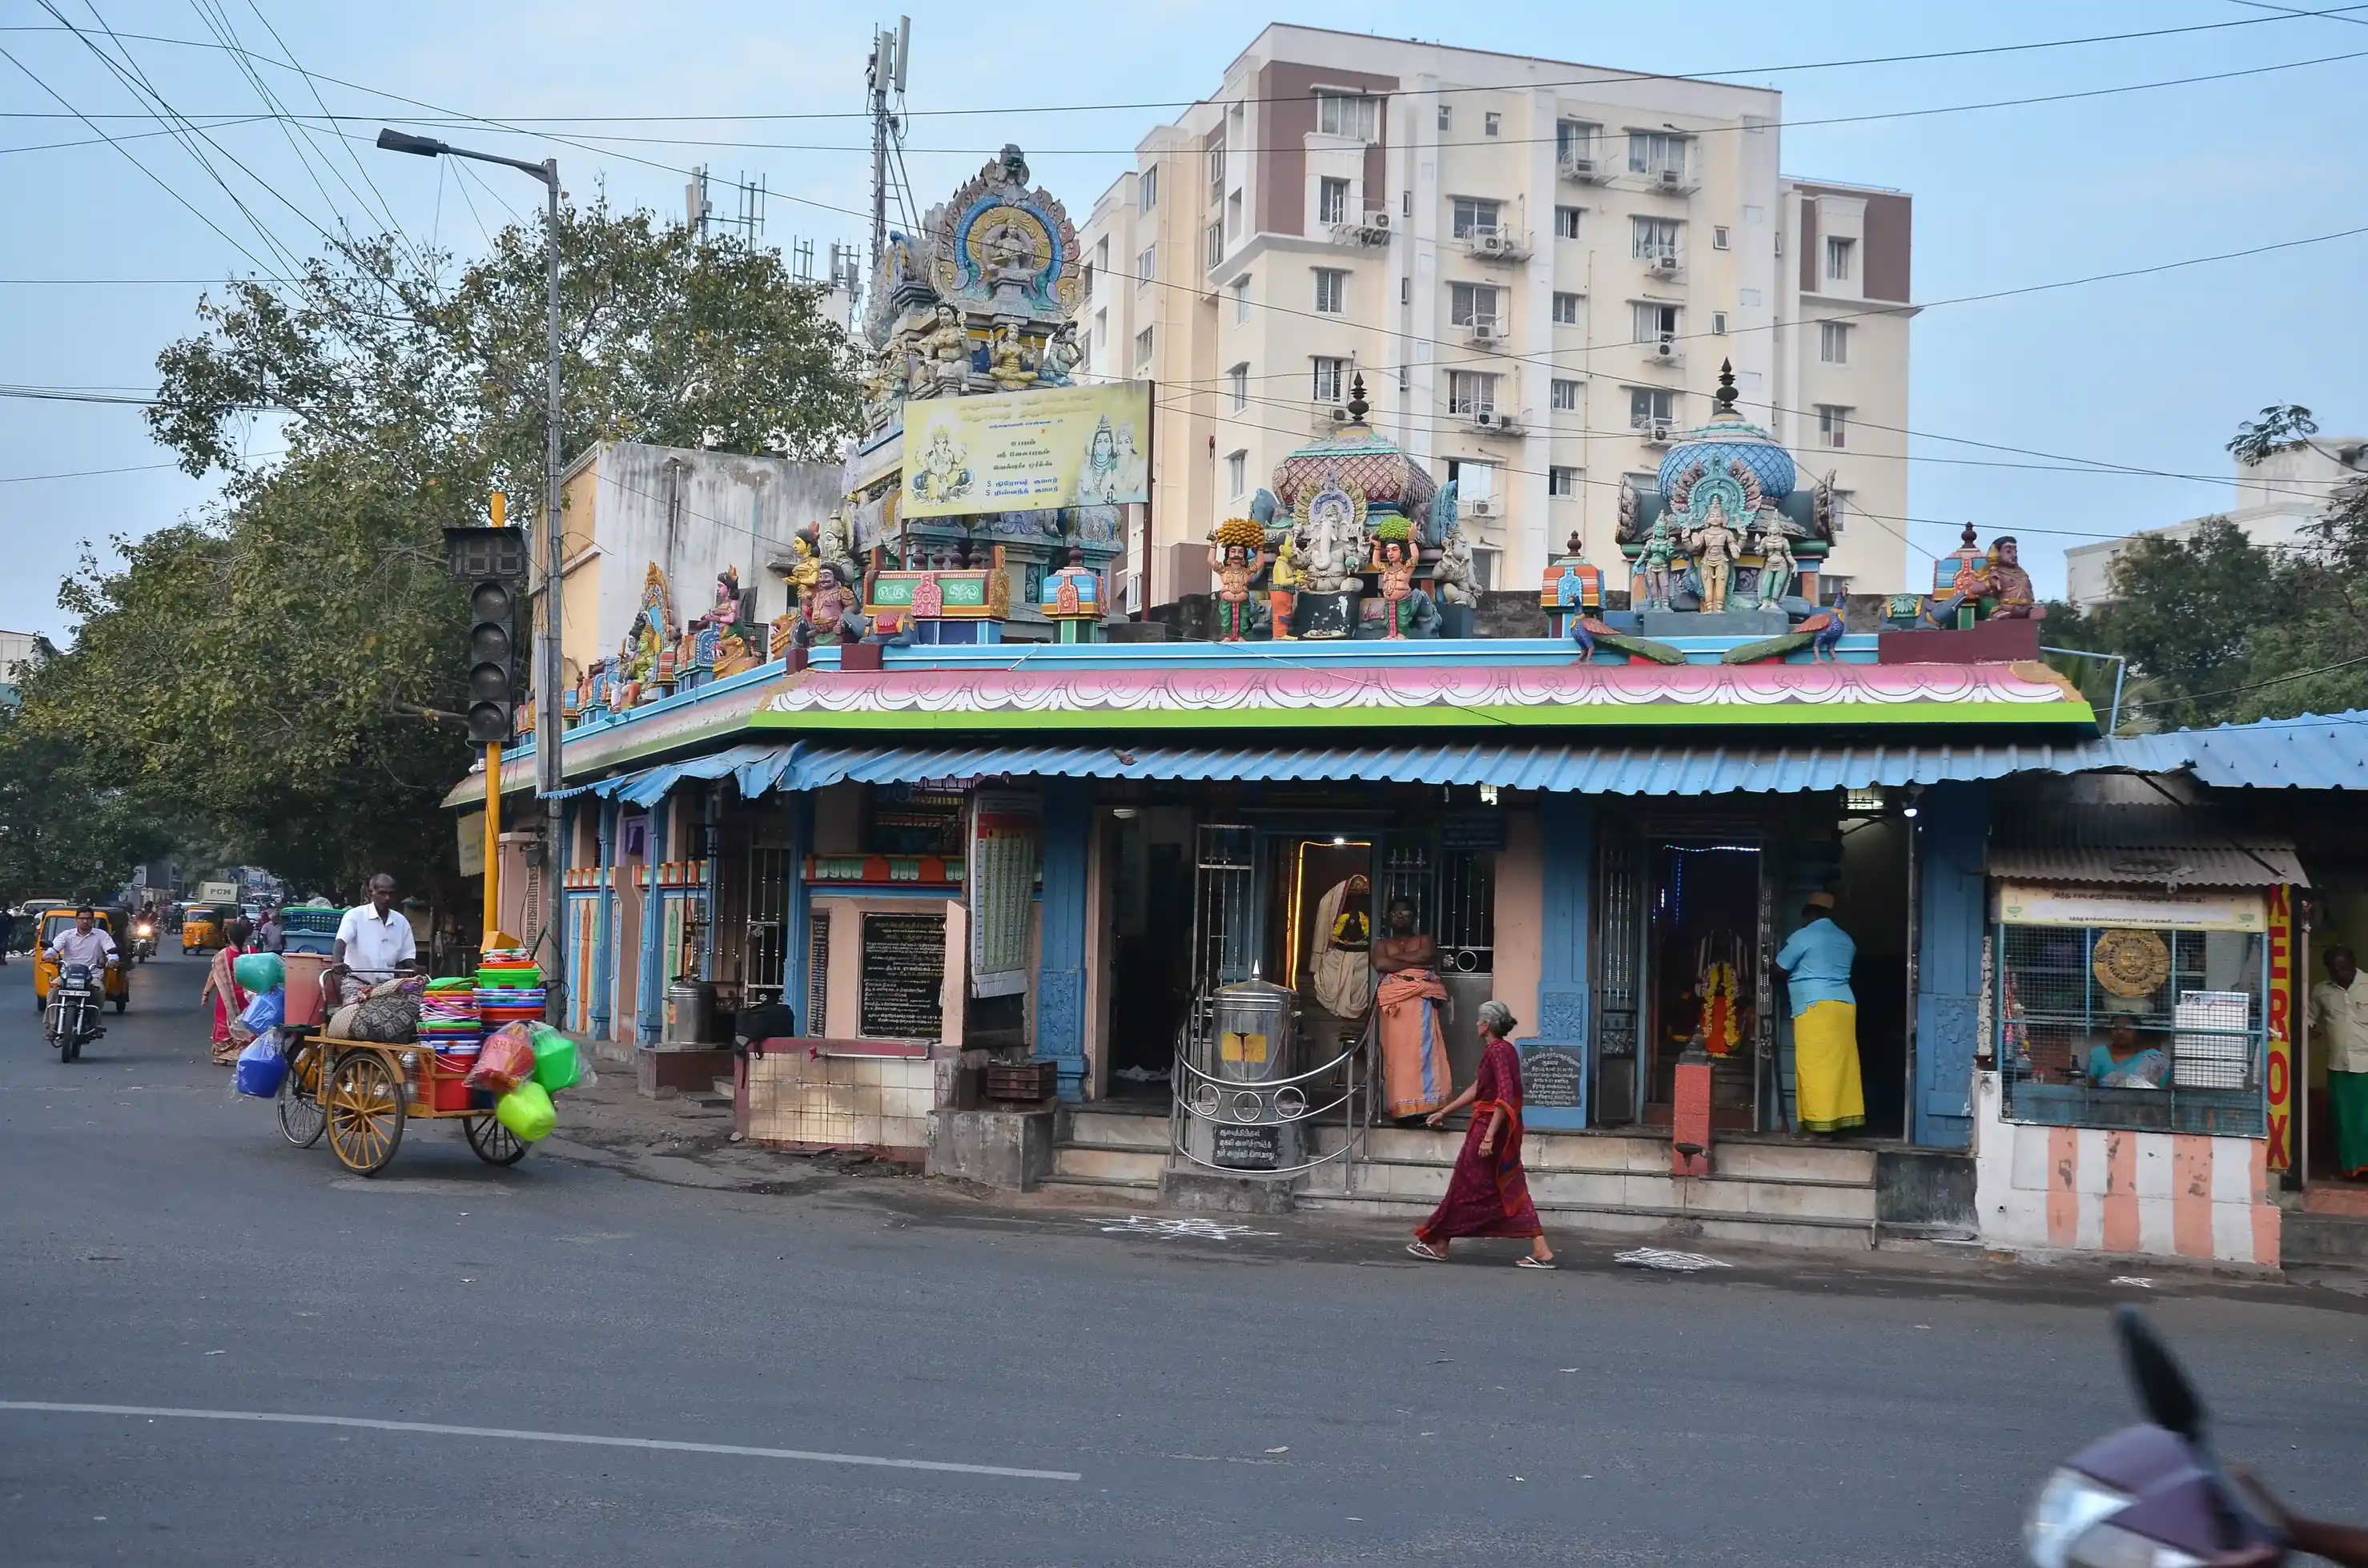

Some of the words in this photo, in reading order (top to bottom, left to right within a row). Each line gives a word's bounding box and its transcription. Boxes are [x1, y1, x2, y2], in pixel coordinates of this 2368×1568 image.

[1033, 476, 1058, 485] குமார்
[1035, 485, 1059, 493] குமார்
[2267, 883, 2289, 1168] XEROX
